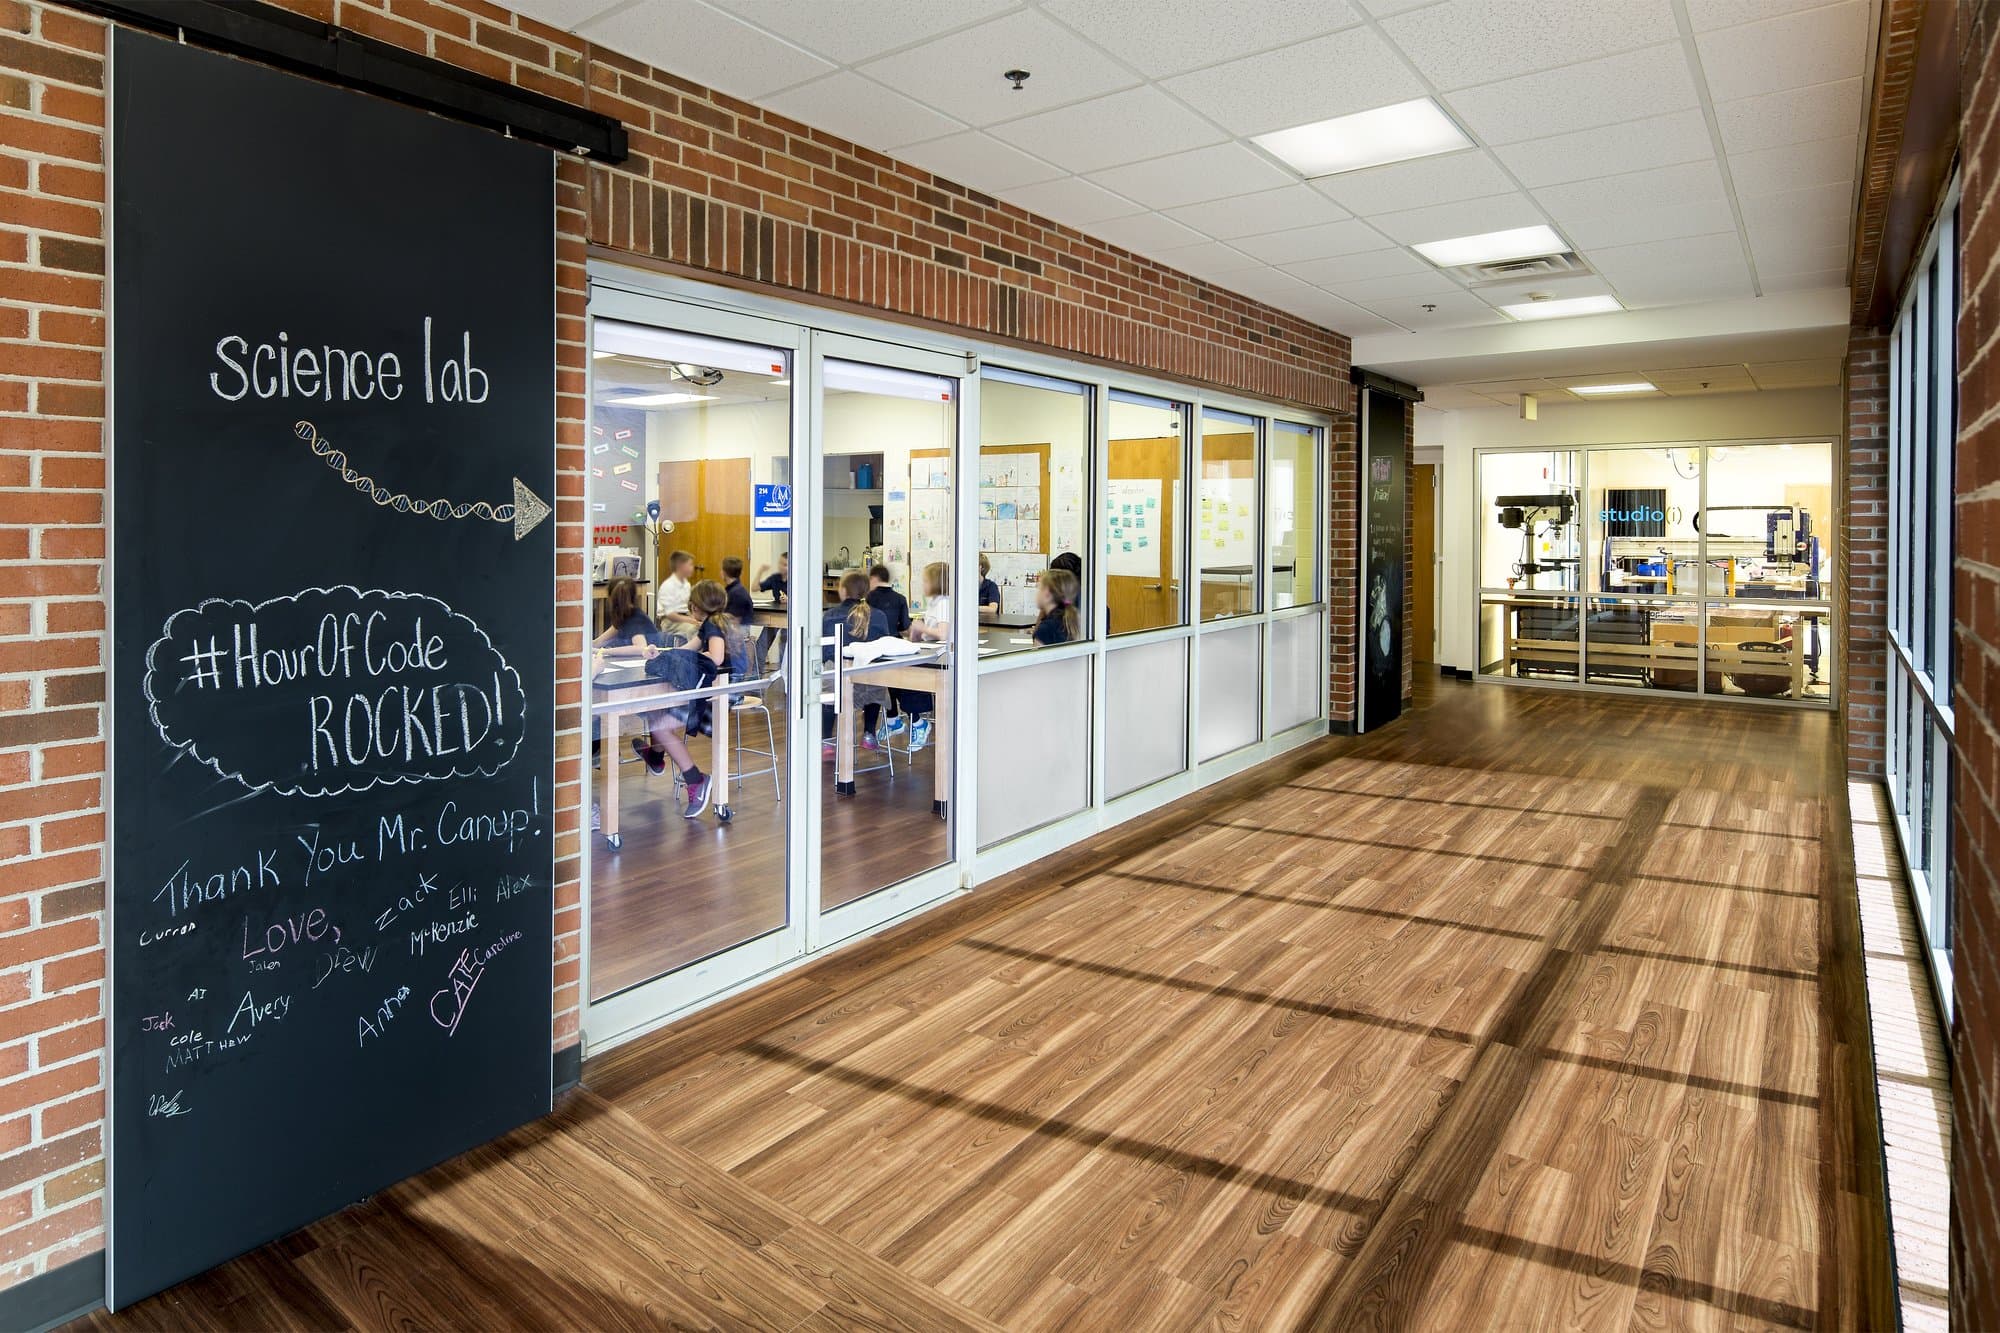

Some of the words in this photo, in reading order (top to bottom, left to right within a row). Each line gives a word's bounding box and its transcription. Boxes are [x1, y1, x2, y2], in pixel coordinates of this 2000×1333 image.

[210, 331, 403, 402] Science
[424, 316, 490, 404] lab
[1599, 504, 1682, 525] studio(i)
[178, 610, 447, 690] #HourOfCode
[309, 671, 505, 775] ROCKED!
[152, 849, 280, 917] Thank
[298, 831, 365, 887] You
[379, 814, 428, 861] Mr.
[438, 776, 541, 853] Canup!
[374, 872, 439, 932] Zack
[496, 873, 534, 903] Alex
[243, 908, 341, 960] Love,
[141, 1011, 176, 1032] Jack
[227, 990, 291, 1034] Avery
